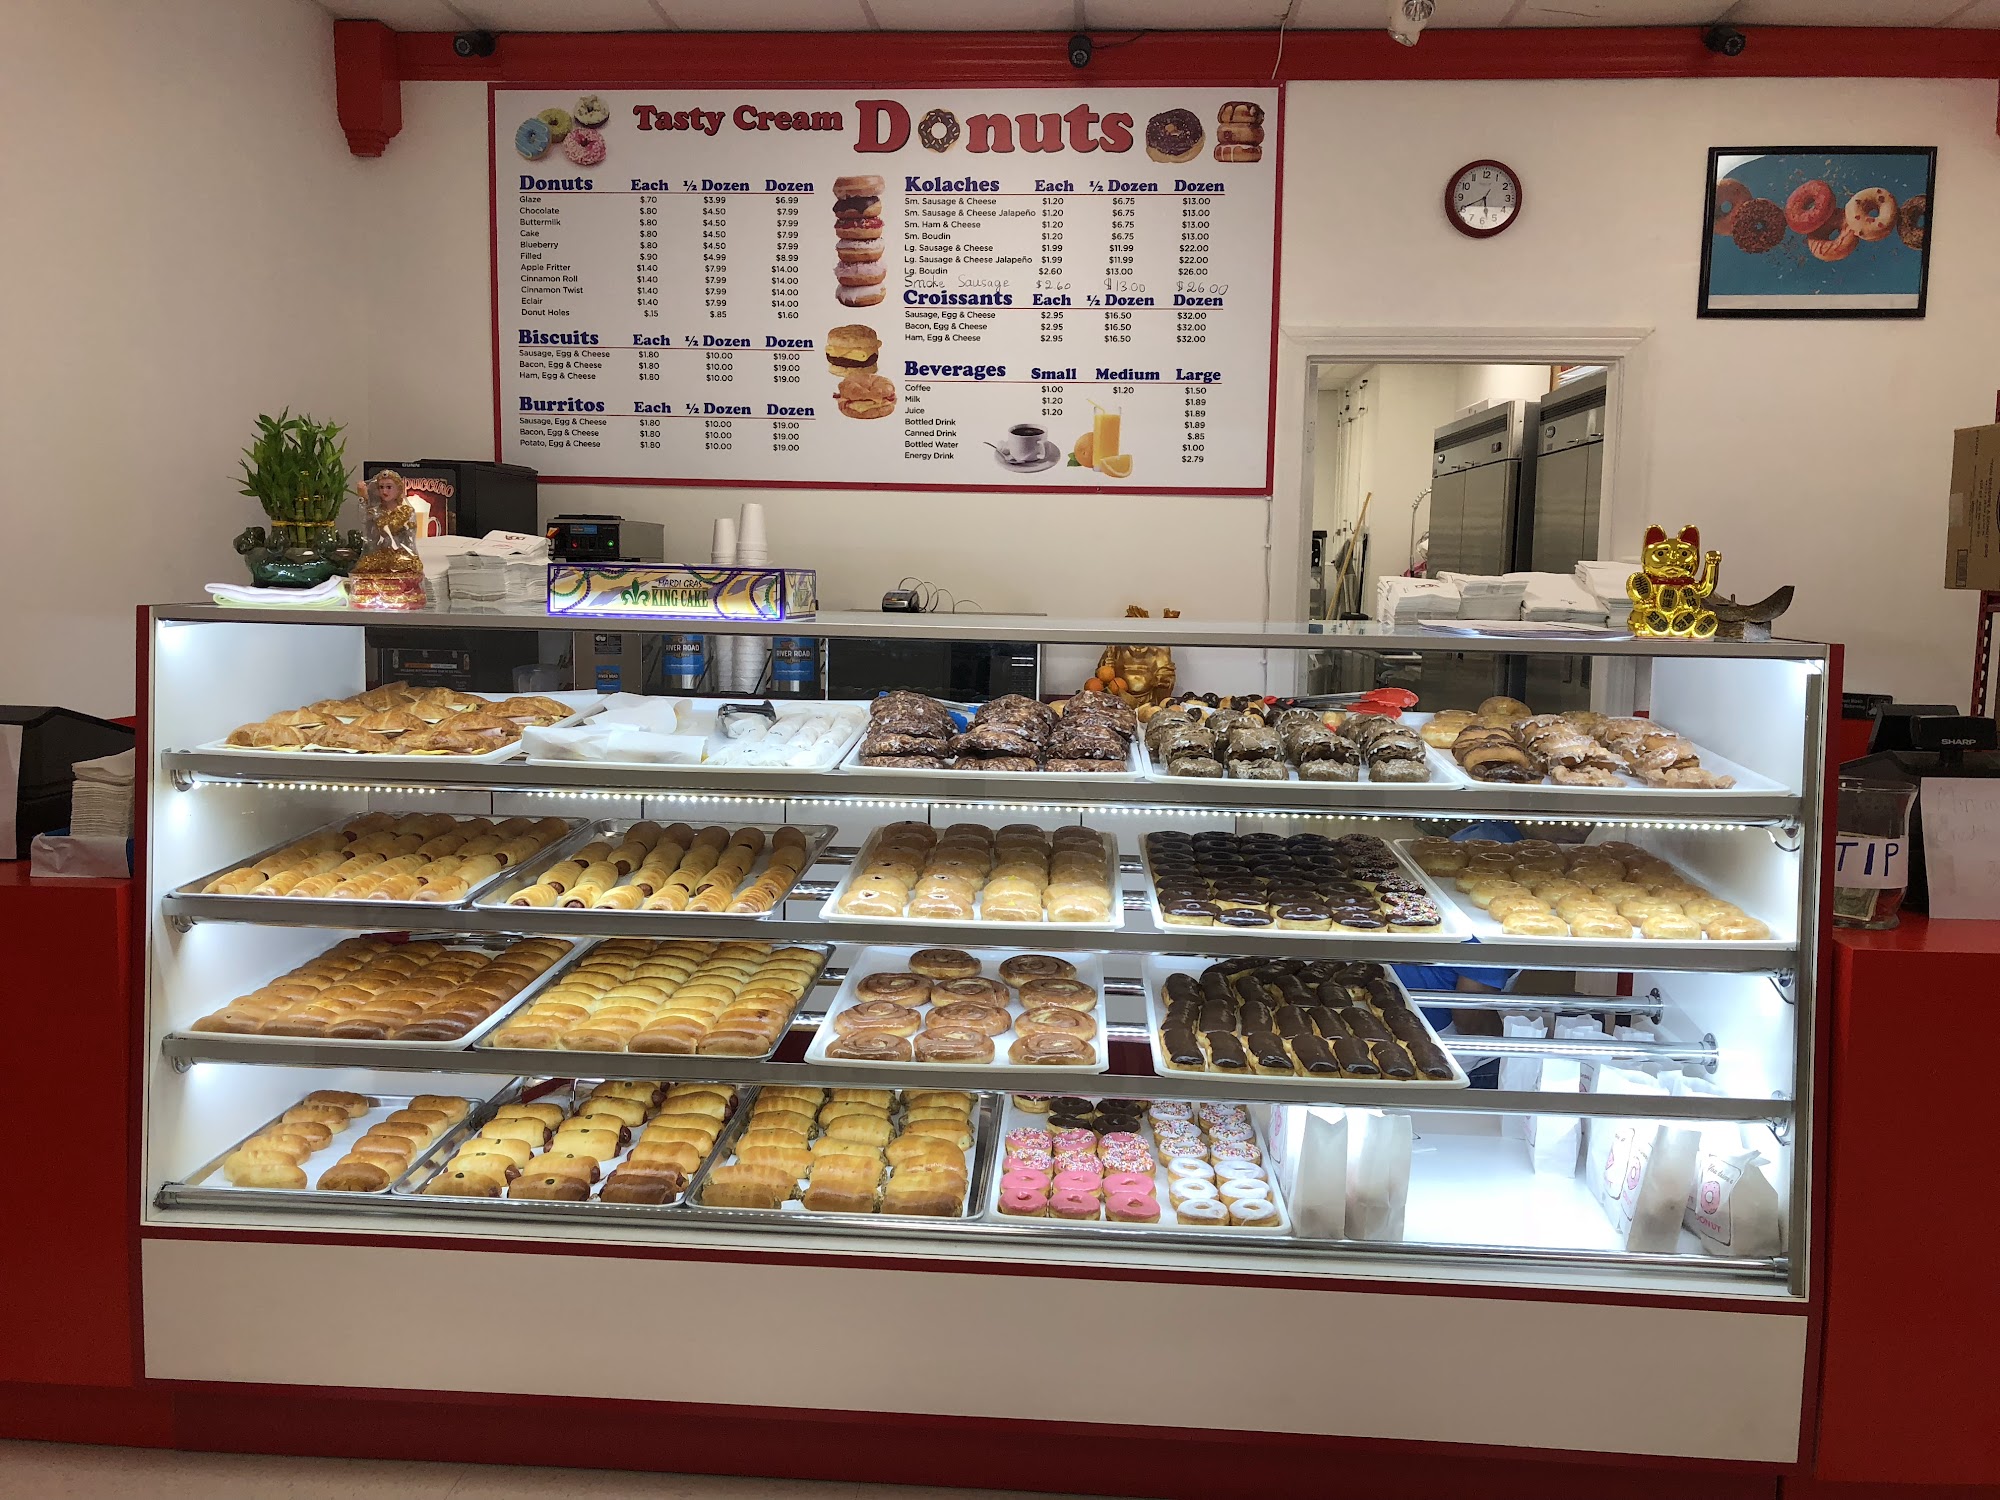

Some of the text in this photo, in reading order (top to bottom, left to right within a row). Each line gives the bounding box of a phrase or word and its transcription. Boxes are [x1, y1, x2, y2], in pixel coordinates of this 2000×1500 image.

[633, 105, 725, 136] Tasty
[732, 105, 844, 131] Cream
[1496, 174, 1499, 182] 1
[519, 175, 593, 190] Donuts
[631, 179, 669, 191] Each
[701, 179, 750, 191] Dozen
[765, 179, 814, 191] Dozen
[905, 176, 999, 192] Kolaches
[1034, 179, 1074, 192] Each
[1107, 179, 1158, 192] Dozen
[1174, 179, 1225, 192] Dozen
[519, 195, 541, 203] Glaze
[704, 196, 726, 204] $3.99
[775, 196, 798, 204] $6.99
[1458, 193, 1464, 201] 9
[922, 209, 956, 218] Sausage
[999, 209, 1036, 217] Jalapeño
[1042, 209, 1063, 217] $1.20
[1112, 209, 1135, 217] $6.75
[1182, 209, 1210, 217] $13.00
[1492, 214, 1497, 222] 5
[703, 219, 726, 227] $4.50
[922, 232, 951, 240] Boudin
[1042, 232, 1063, 240] $1.20
[1111, 232, 1134, 240] $6.75
[1181, 233, 1209, 241] $13.00
[520, 241, 558, 249] Blueberry
[703, 242, 726, 250] $4.50
[521, 264, 544, 272] Apple
[637, 264, 658, 272] $1.40
[705, 265, 726, 273] $7.99
[904, 274, 946, 288] Smoke
[957, 274, 1010, 291] Sausage
[637, 287, 658, 295] $1.40
[772, 288, 798, 296] $14.00
[903, 289, 1013, 306] Croissants
[1032, 293, 1072, 306] Each
[1104, 294, 1155, 306] Dozen
[1173, 294, 1223, 306] Dozen
[778, 311, 799, 319] $1.60
[905, 311, 939, 319] Sausage,
[942, 311, 957, 320] Egg
[1041, 311, 1063, 319] $2.95
[1105, 312, 1132, 320] $16.50
[1177, 312, 1207, 320] $32.00
[518, 329, 599, 345] Biscuits
[633, 334, 671, 346] Each
[703, 335, 751, 347] Dozen
[765, 336, 814, 348] Dozen
[519, 350, 554, 358] Sausage,
[556, 350, 571, 358] Egg
[904, 361, 1221, 382] Beverages Small Medium Large
[1041, 385, 1063, 393] $1.00
[1113, 386, 1134, 394] $1.20
[1185, 387, 1207, 395] $1.50
[519, 396, 605, 412] Burritos
[634, 401, 671, 413] Each
[703, 402, 752, 415] Dozen
[767, 403, 815, 416] Dozen
[1042, 397, 1063, 405] $1.20
[1185, 398, 1206, 406] $1.89
[1042, 408, 1063, 416] $1.20
[1185, 410, 1206, 418] $1.89
[520, 417, 553, 425] Sausage,
[555, 418, 570, 426] Egg
[640, 419, 660, 427] $1.80
[705, 420, 732, 428] $10.00
[773, 421, 799, 429] $19.00
[935, 418, 956, 426] Drink
[1184, 421, 1205, 429] $1.89
[905, 429, 934, 437] Canned
[1182, 444, 1204, 452] $1.00
[905, 452, 932, 460] Energy
[1182, 455, 1204, 463] $2.79
[658, 579, 703, 588] MARDI GRAS
[651, 589, 709, 608] KING CAKE
[665, 644, 700, 652] RIVER ROAD
[1836, 842, 1899, 876] TIP
